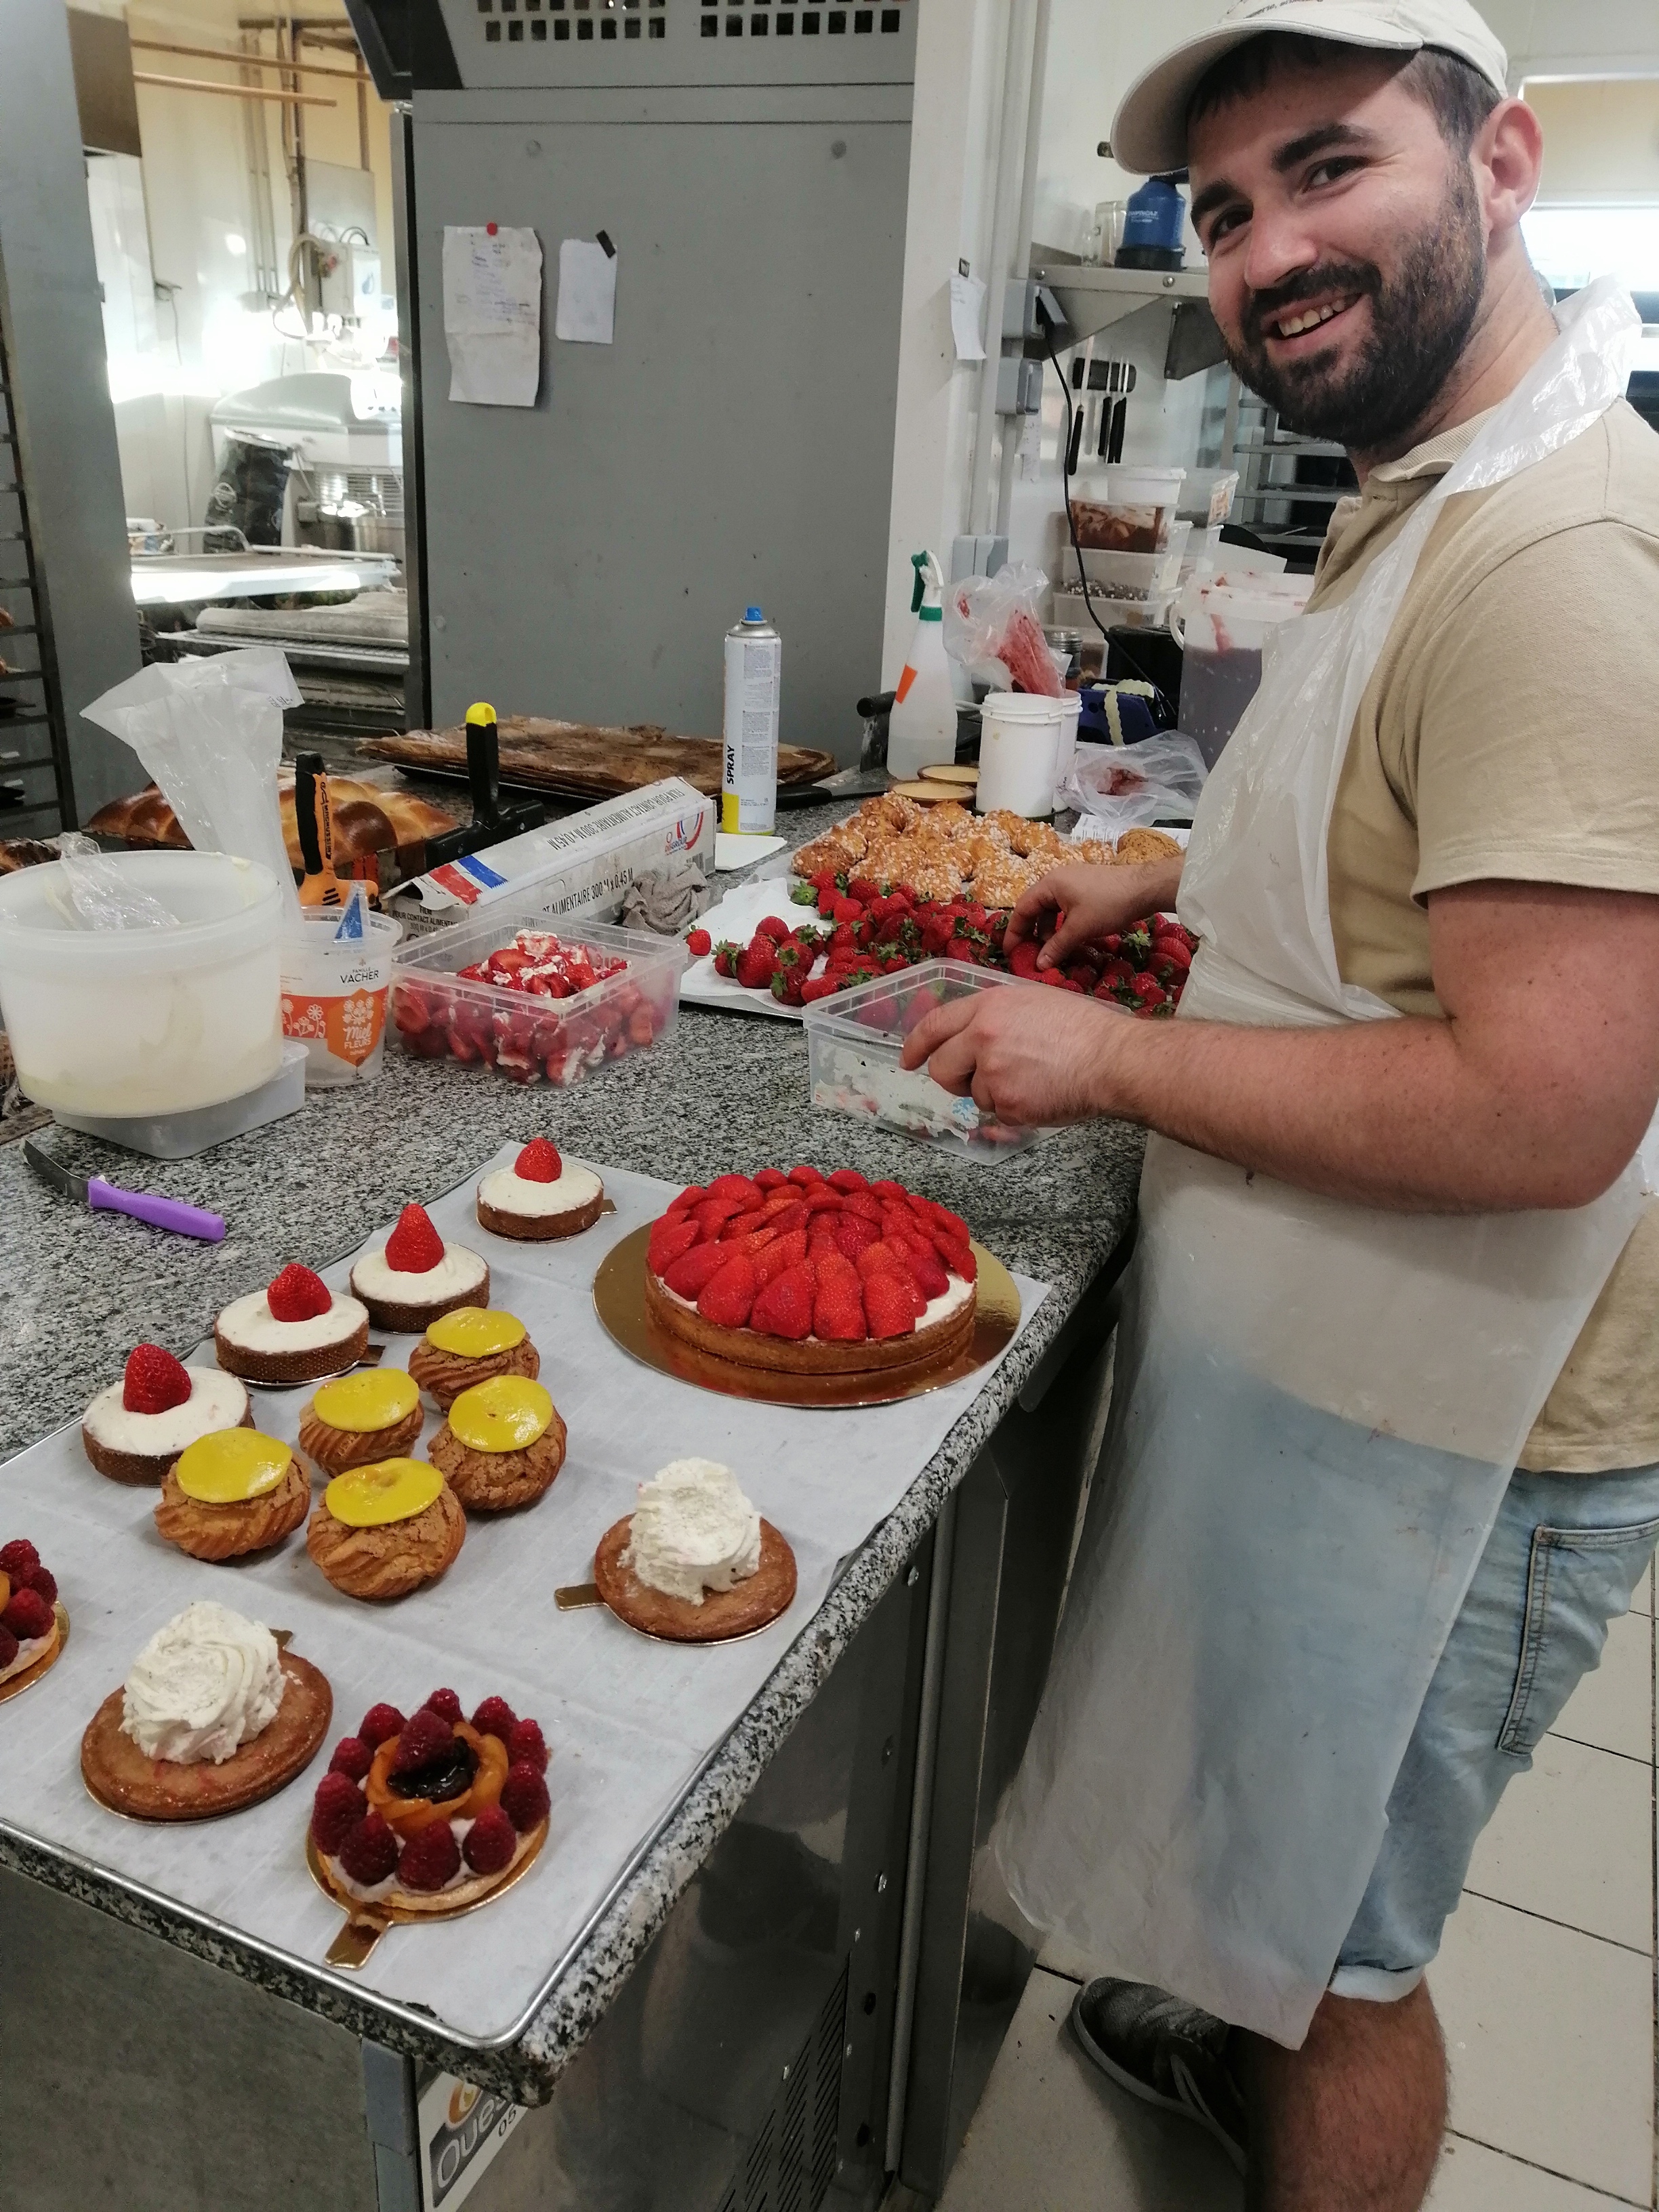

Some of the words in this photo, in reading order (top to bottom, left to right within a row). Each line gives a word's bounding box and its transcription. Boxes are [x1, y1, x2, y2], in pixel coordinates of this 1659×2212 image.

[726, 744, 735, 785] SPRAY
[651, 792, 673, 806] POUR
[627, 798, 657, 817] CONTACT
[591, 807, 634, 832] ALIMENTAIRE
[579, 822, 598, 837] 300
[546, 838, 561, 851] M
[552, 887, 591, 915] ALIMENTAIRE
[592, 884, 602, 900] 300
[615, 870, 628, 888] 0,45
[628, 867, 634, 883] M
[392, 909, 407, 920] POUR
[407, 912, 429, 923] CONTACT
[340, 970, 379, 983] VACHER
[342, 1022, 373, 1041] Miel
[344, 1038, 371, 1050] FLEURS
